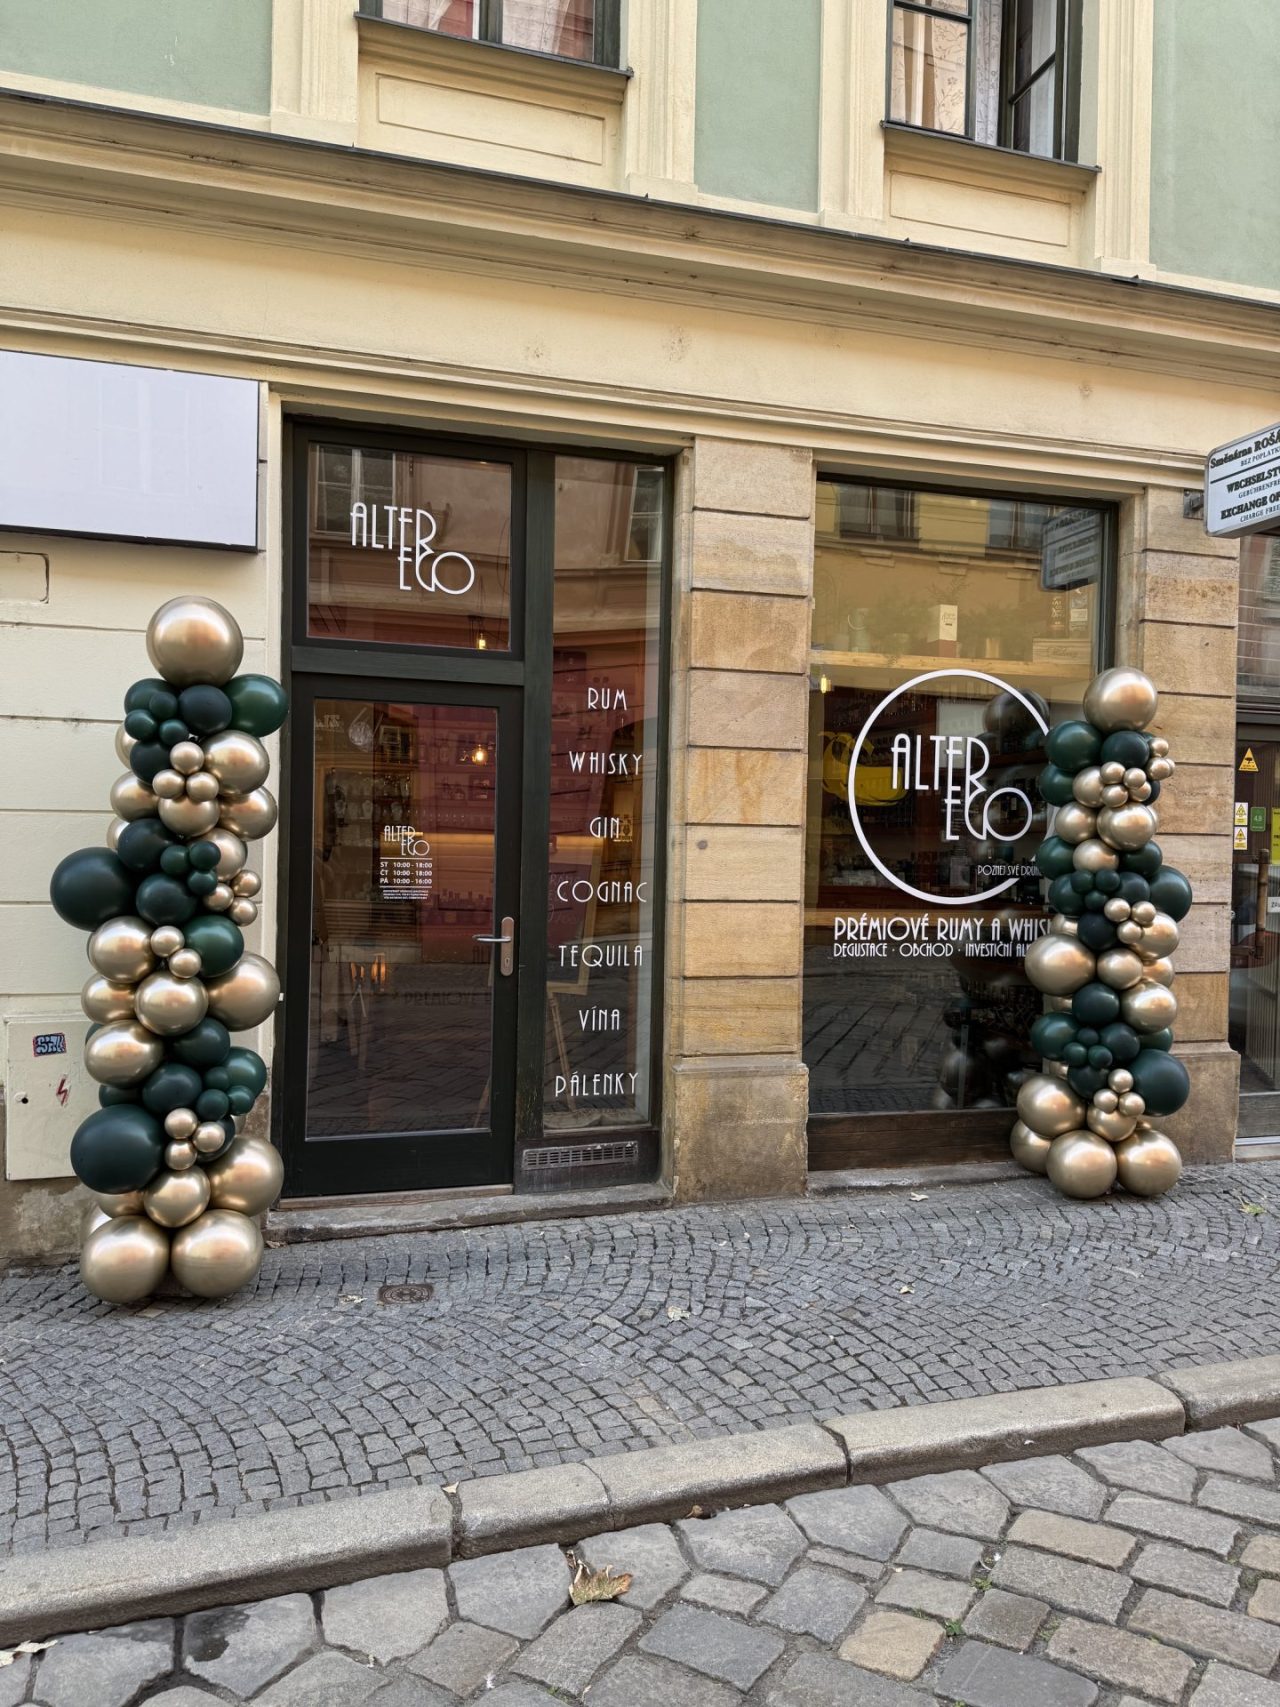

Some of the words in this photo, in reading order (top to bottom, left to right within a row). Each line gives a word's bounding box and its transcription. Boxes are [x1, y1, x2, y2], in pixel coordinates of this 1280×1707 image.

[1210, 447, 1252, 469] Směnárna
[1241, 457, 1251, 466] BEZ
[1252, 446, 1280, 462] POPLATK
[1226, 466, 1280, 493] WECHSELST
[1221, 496, 1268, 520] EXCHANGE
[1240, 509, 1264, 522] CHARGE
[350, 502, 437, 553] ALTER
[398, 546, 475, 595] EGO
[587, 687, 627, 711] RUM
[569, 751, 643, 775] WHISKY
[891, 733, 990, 791] ALTER
[944, 785, 1033, 842] EGO
[384, 825, 416, 844] ALTER
[589, 816, 620, 839] GIN
[401, 839, 430, 856] EGO
[977, 864, 1006, 876] POZNEJ
[1007, 864, 1020, 876] SVÉ
[557, 880, 648, 903] COGNAC
[834, 913, 929, 941] PRÉMIOVÉ
[937, 917, 984, 941] RUMY
[991, 917, 1001, 941] A
[1008, 918, 1052, 942] WHIS
[558, 945, 643, 968] TEQUILA
[833, 942, 888, 957] DEGUSTACE
[899, 942, 954, 957] OBCHOD
[965, 940, 1013, 957] INVESTIČNÍ
[578, 1006, 620, 1031] VÍNA
[555, 1071, 639, 1097] PÁLENKY
